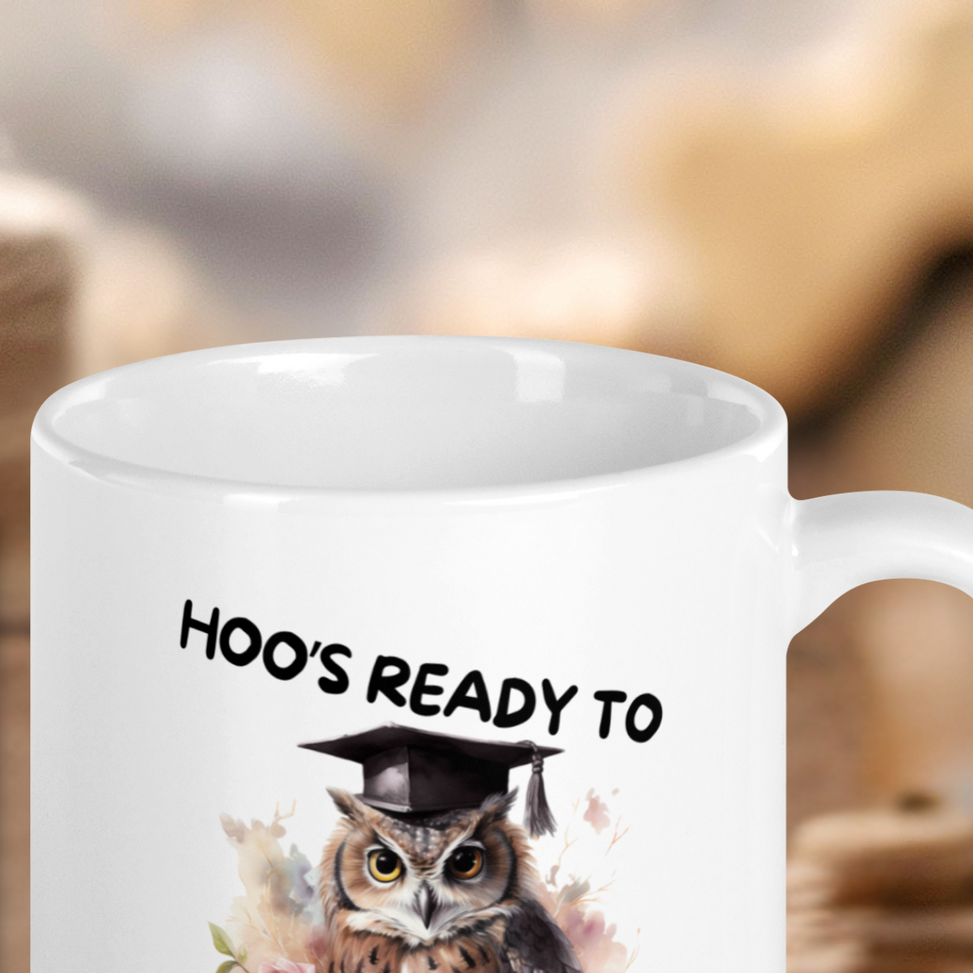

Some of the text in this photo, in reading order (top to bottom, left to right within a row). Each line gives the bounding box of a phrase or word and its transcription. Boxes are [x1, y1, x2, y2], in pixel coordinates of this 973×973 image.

[180, 599, 663, 743] HOO'S READY TO
